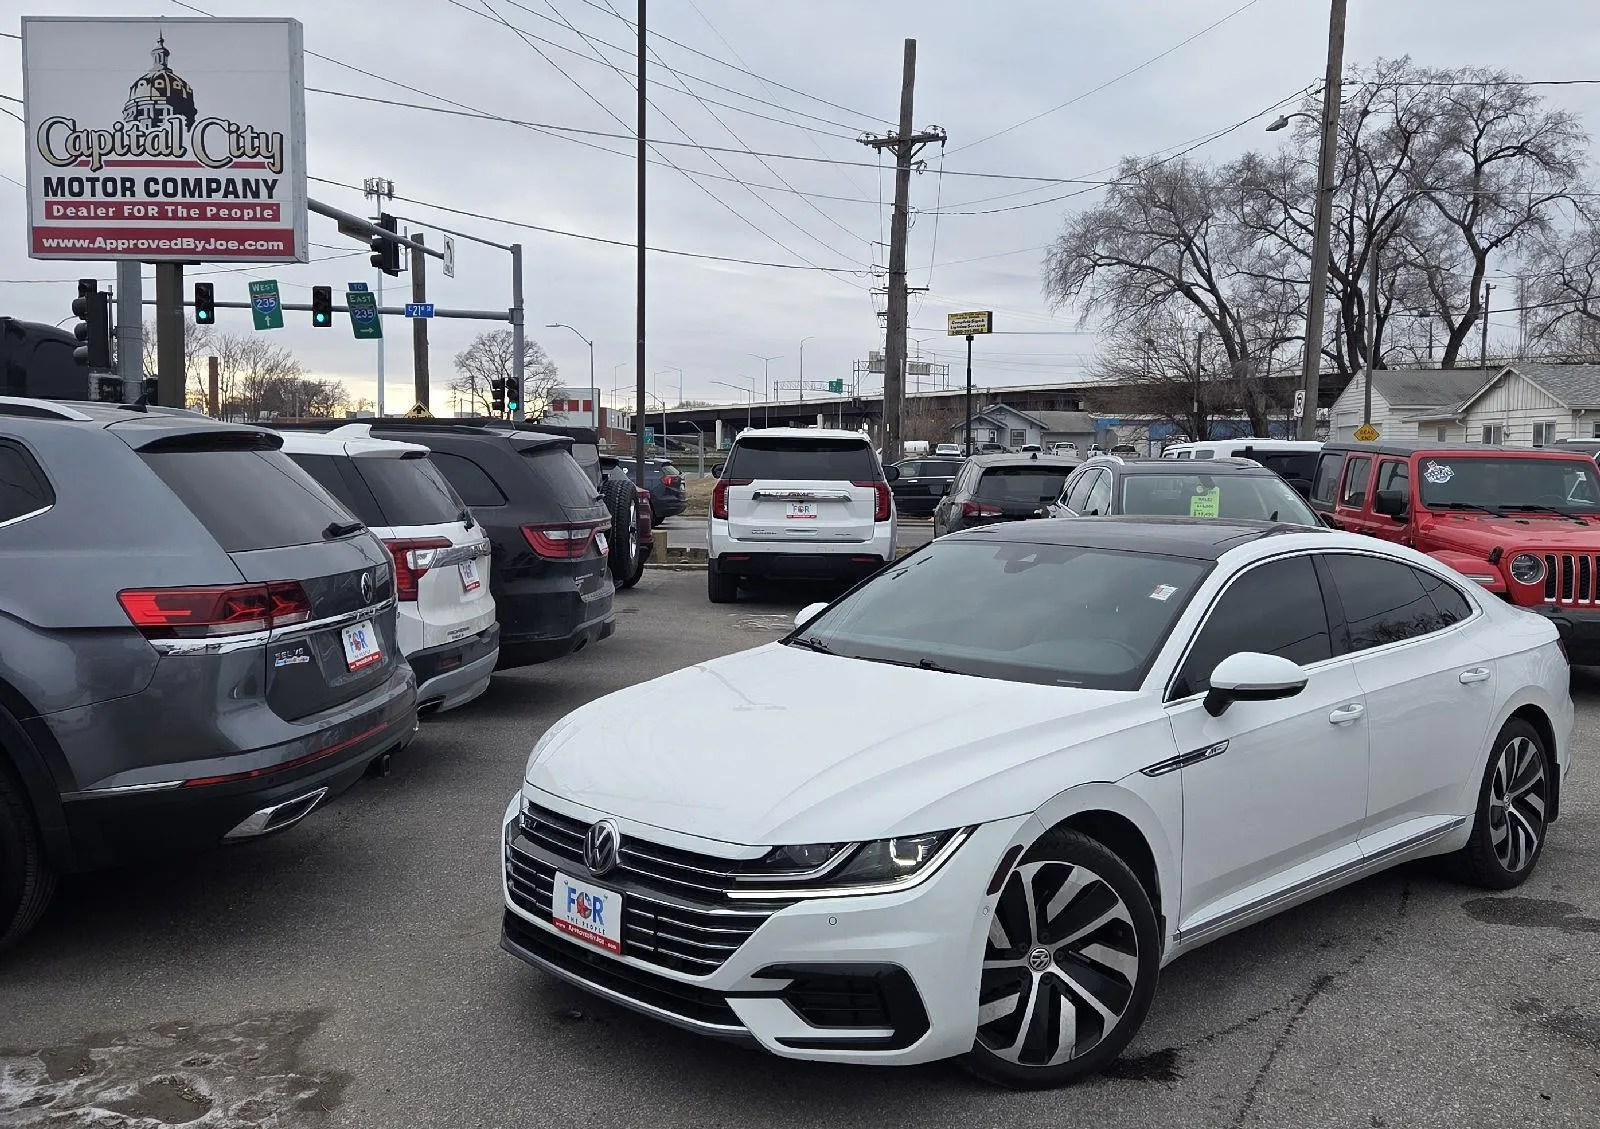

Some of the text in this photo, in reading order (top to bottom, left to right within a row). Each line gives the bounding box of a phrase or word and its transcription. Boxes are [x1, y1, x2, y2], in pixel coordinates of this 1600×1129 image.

[37, 115, 284, 174] Capital City
[43, 176, 279, 200] MOTOR COMPANY
[52, 204, 274, 221] Dealer FOR The People
[41, 236, 284, 252] www.ApprovedByJoe.com
[252, 283, 275, 292] WEST
[256, 297, 276, 309] 235
[350, 294, 372, 303] EAST
[354, 308, 374, 319] 235
